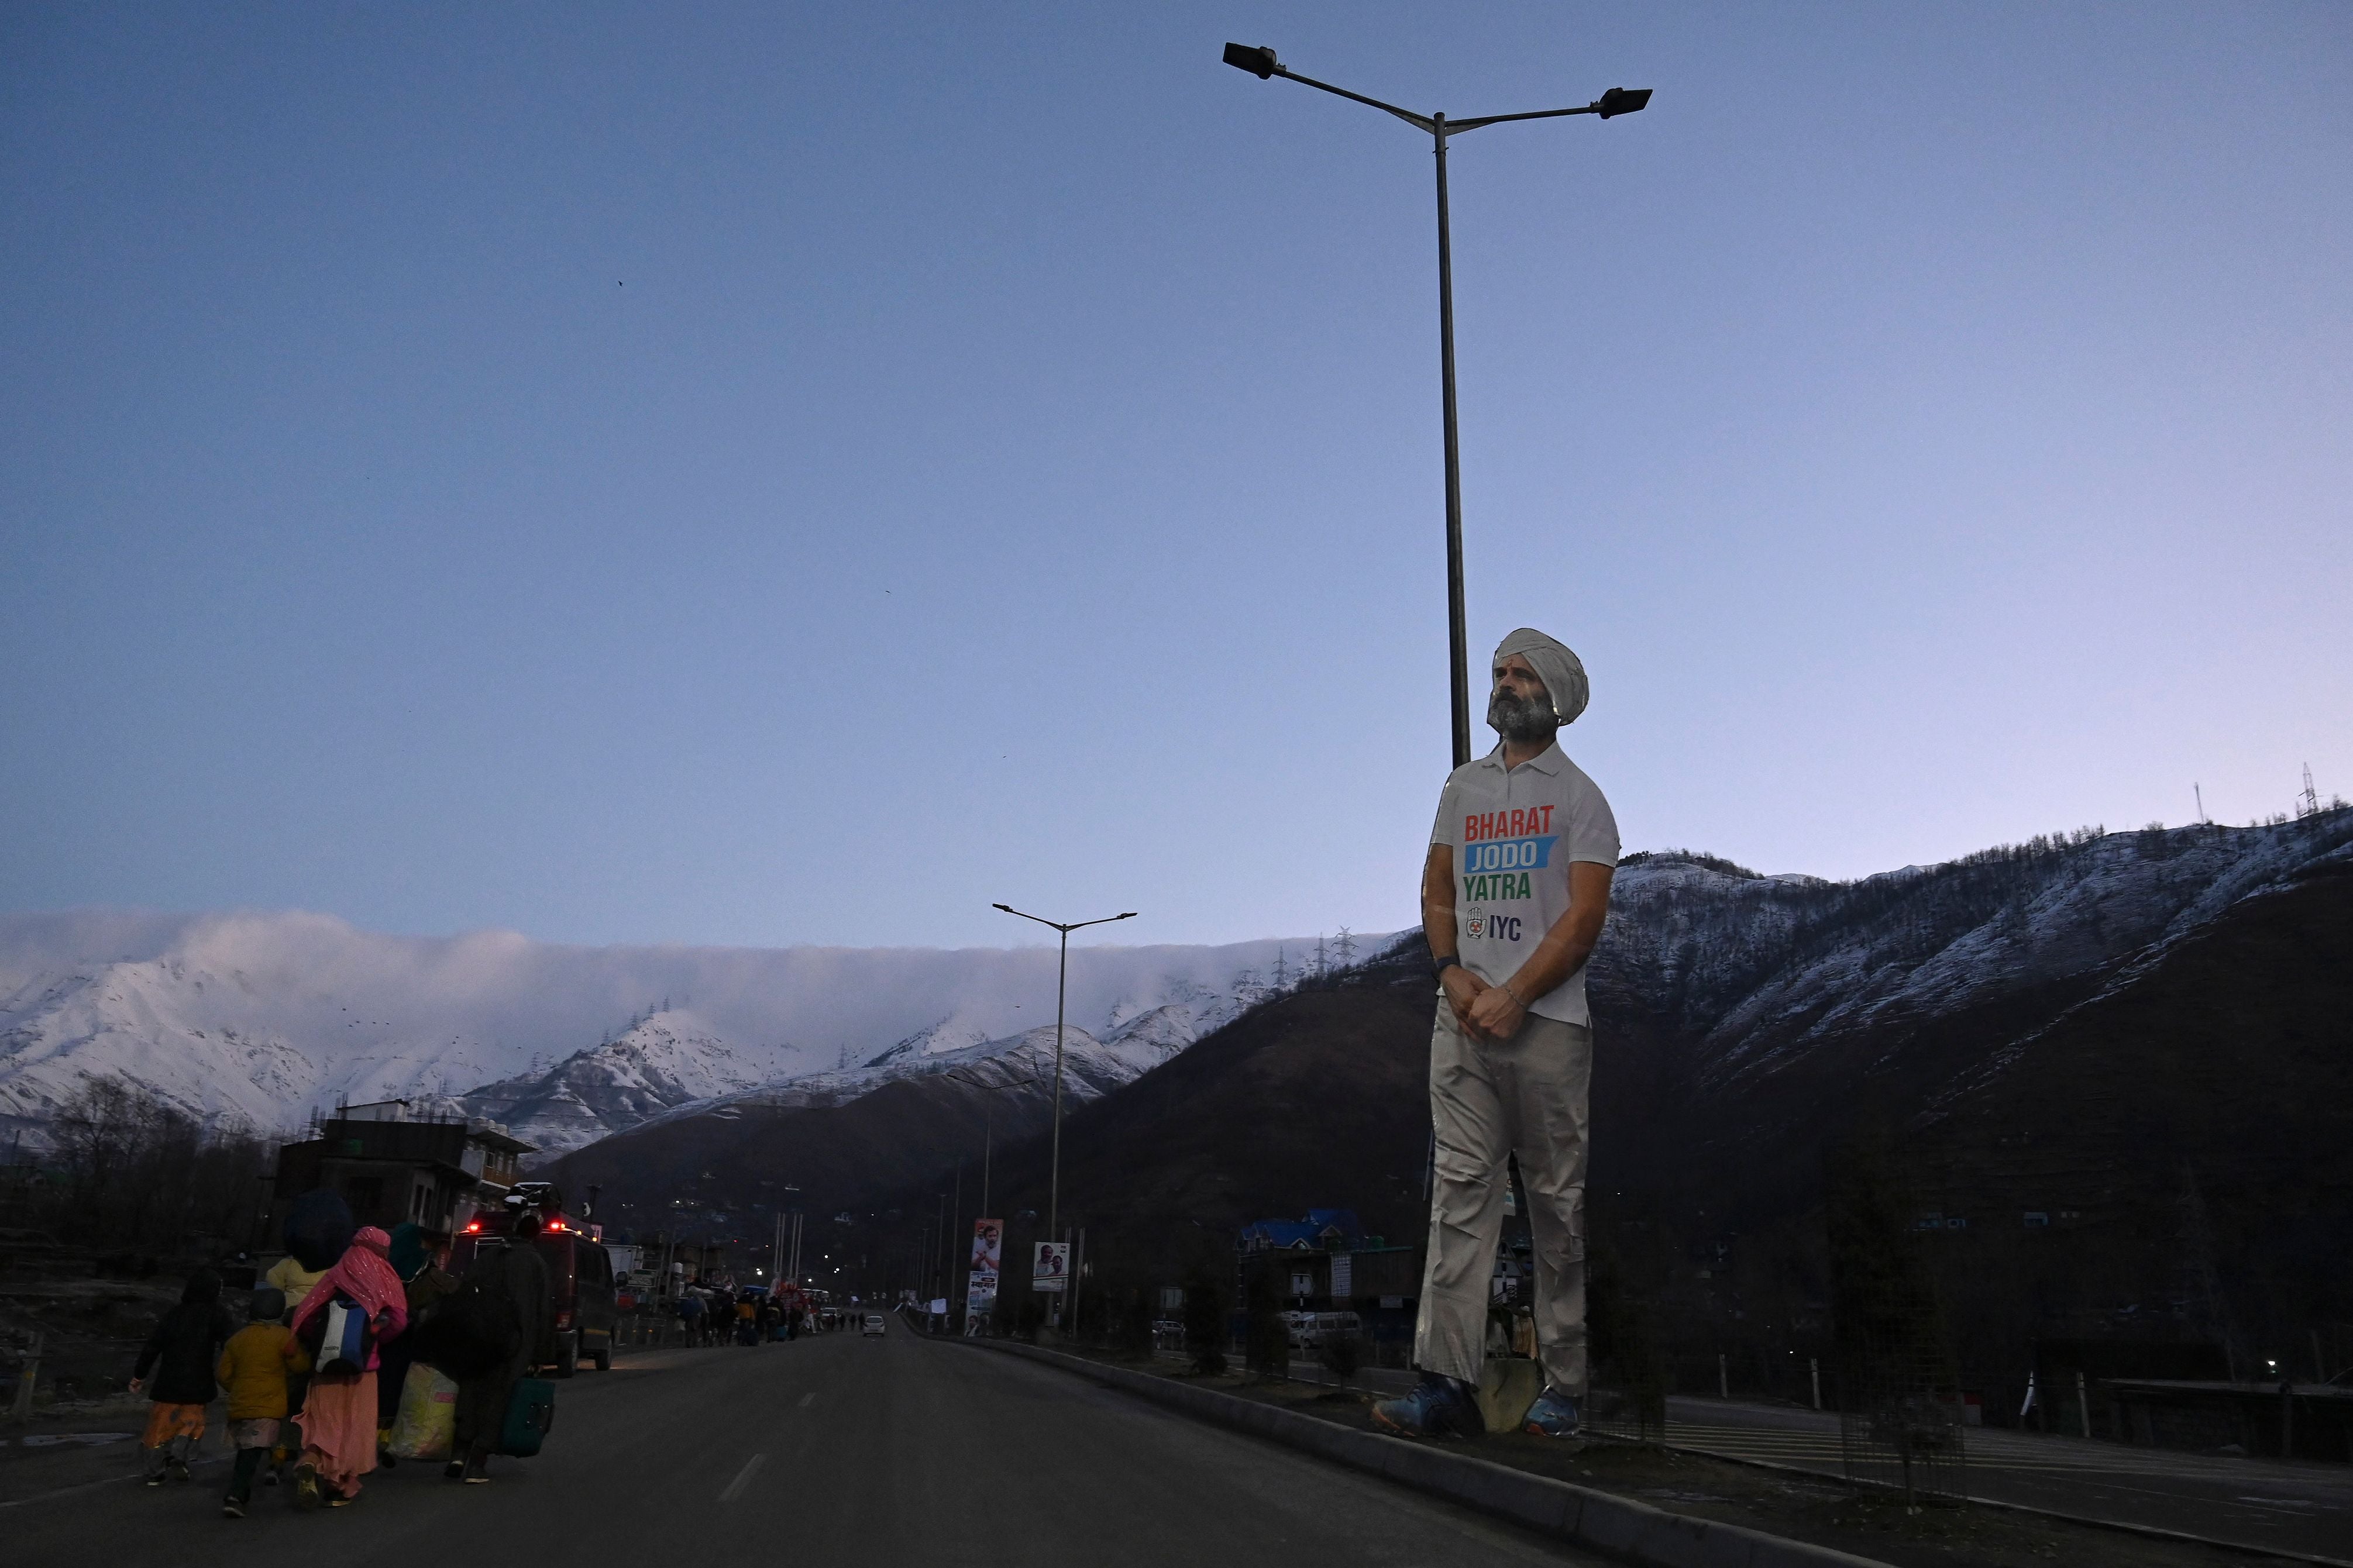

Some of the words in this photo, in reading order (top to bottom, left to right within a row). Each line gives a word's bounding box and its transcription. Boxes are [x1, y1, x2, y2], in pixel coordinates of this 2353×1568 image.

[1465, 805, 1554, 841] BHARAT
[1471, 842, 1536, 870] JODO
[1463, 872, 1531, 902] YATRA
[1489, 915, 1521, 941] IYC
